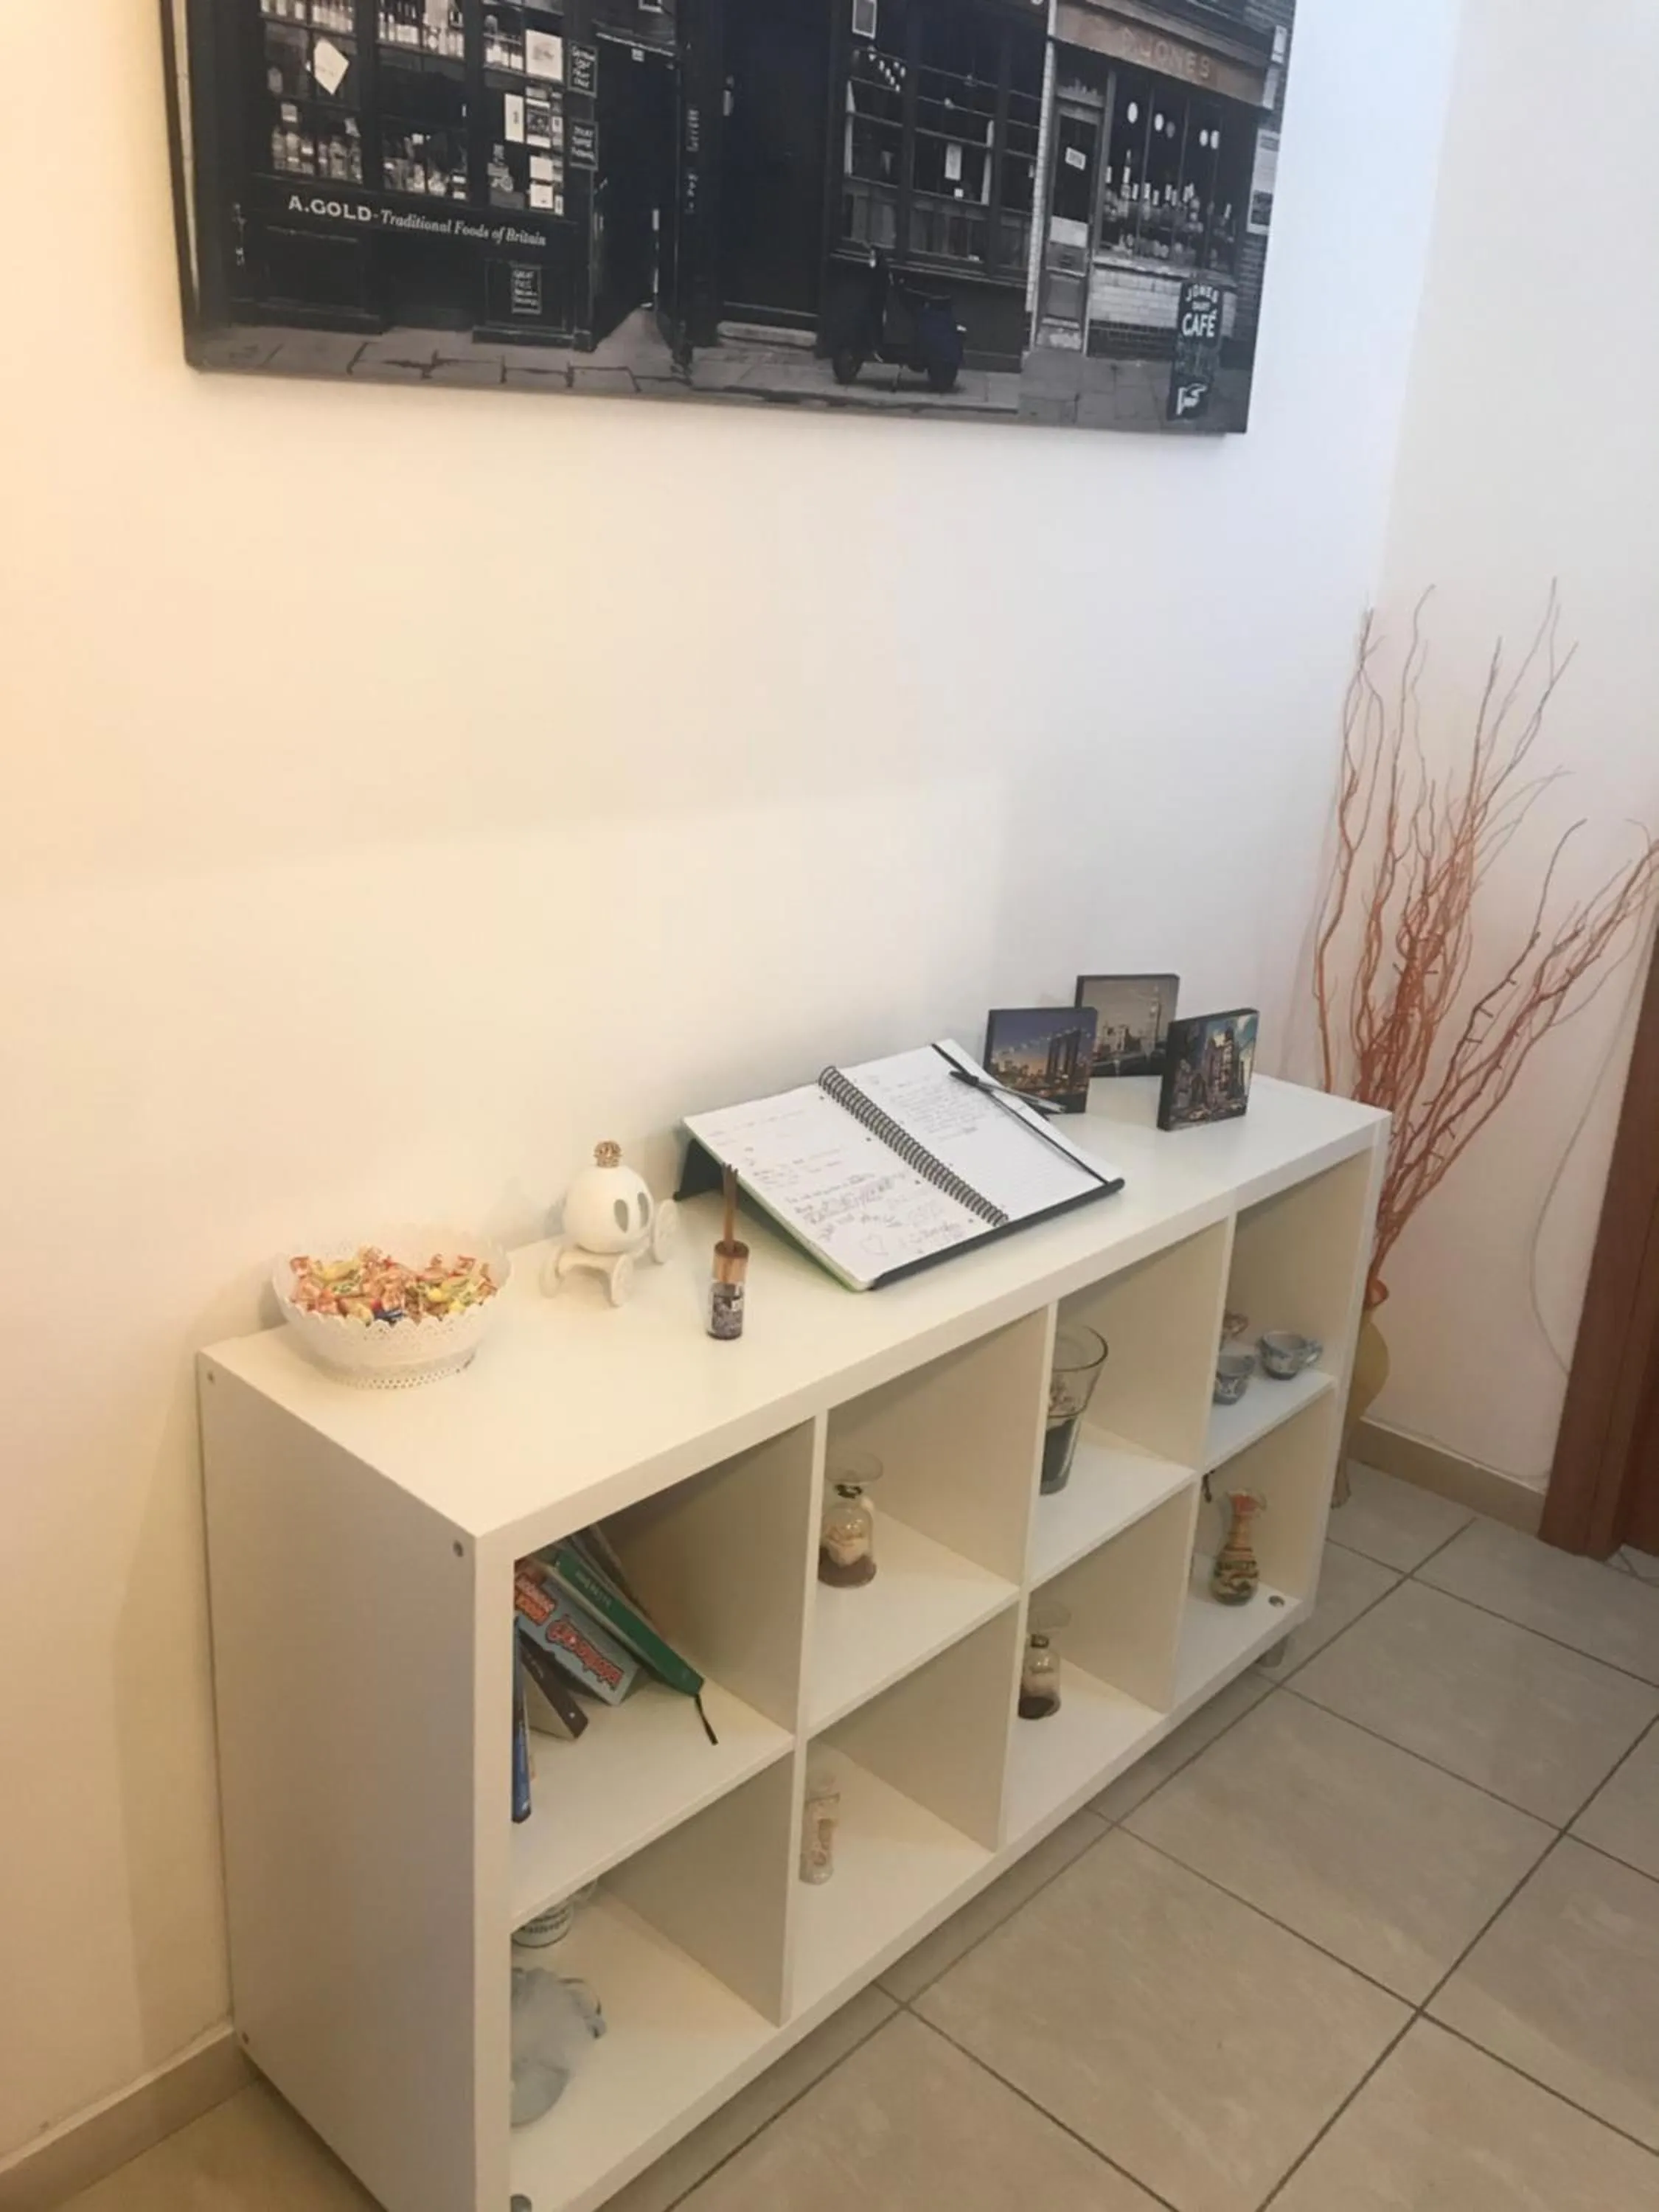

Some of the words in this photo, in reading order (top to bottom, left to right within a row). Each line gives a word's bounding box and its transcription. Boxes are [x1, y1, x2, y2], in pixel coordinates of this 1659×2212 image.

[380, 209, 451, 234] Traditional
[454, 219, 489, 240] Foods
[491, 225, 506, 245] of
[505, 227, 546, 246] Britain
